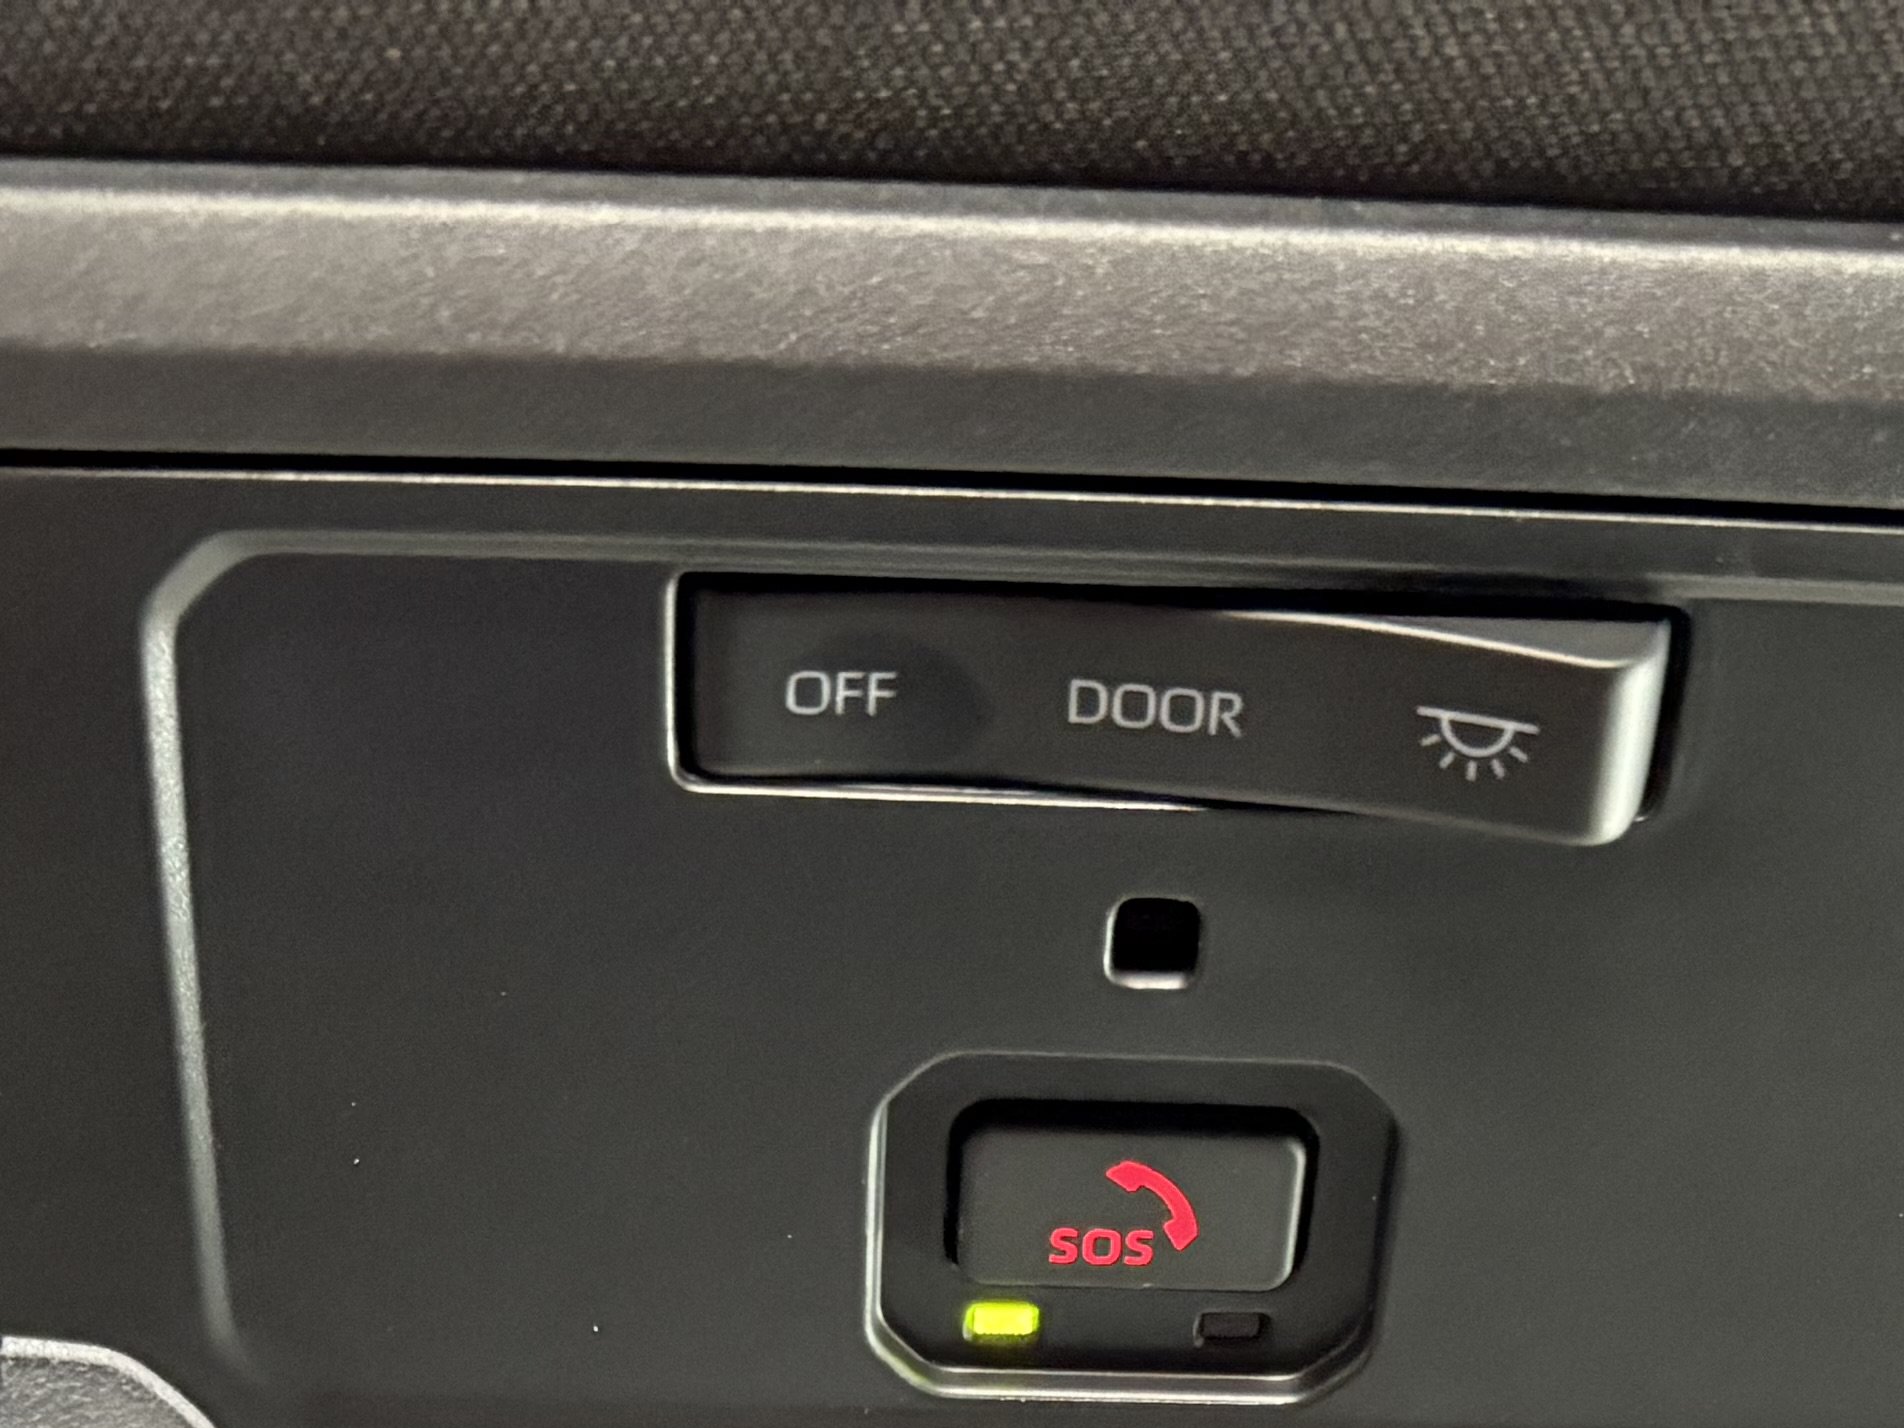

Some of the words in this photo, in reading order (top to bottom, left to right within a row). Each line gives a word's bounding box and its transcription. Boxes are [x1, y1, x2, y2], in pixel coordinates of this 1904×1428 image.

[784, 669, 898, 718] OFF
[1066, 677, 1244, 740] DOOR
[1048, 1227, 1155, 1267] SOS
